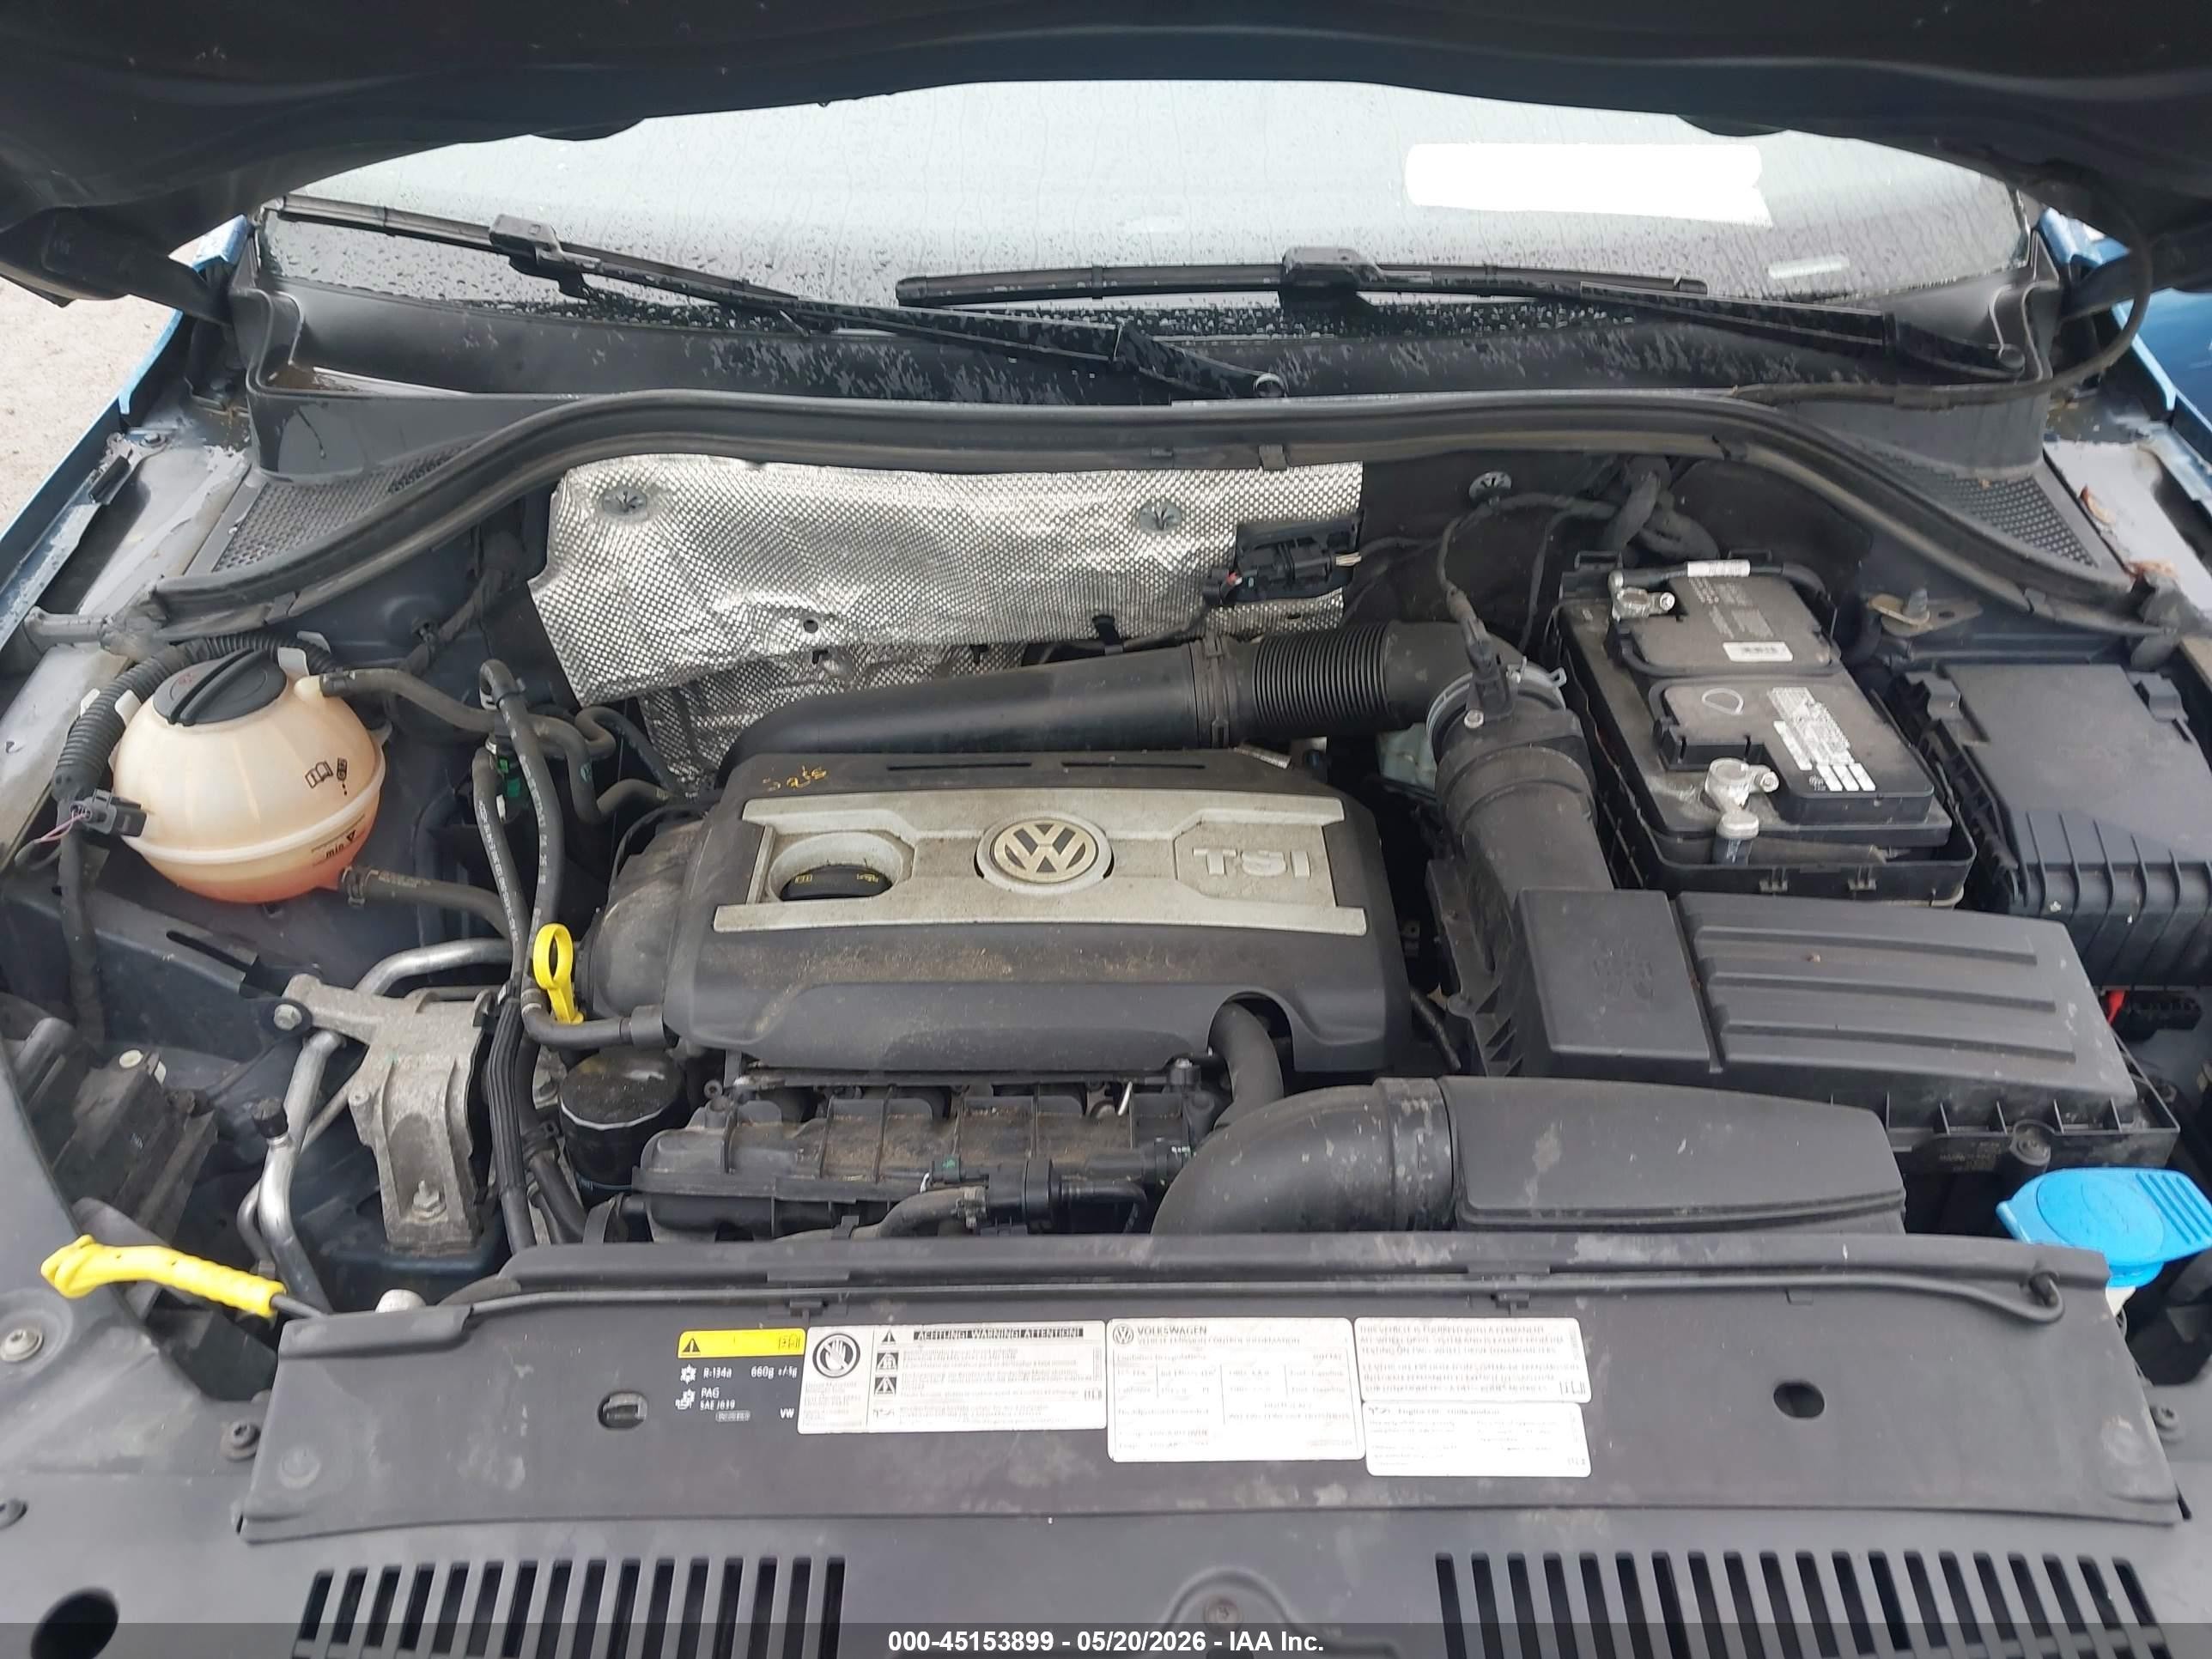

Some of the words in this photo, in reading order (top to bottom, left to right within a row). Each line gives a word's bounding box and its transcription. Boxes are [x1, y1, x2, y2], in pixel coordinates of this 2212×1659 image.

[325, 843, 345, 859] min
[1191, 847, 1312, 878] TSI
[1137, 1326, 1207, 1336] VOLKSWAGEN
[750, 1365, 775, 1380] 660g
[701, 1387, 720, 1399] PAG
[700, 1401, 714, 1411] SAE
[780, 1408, 795, 1419] VW
